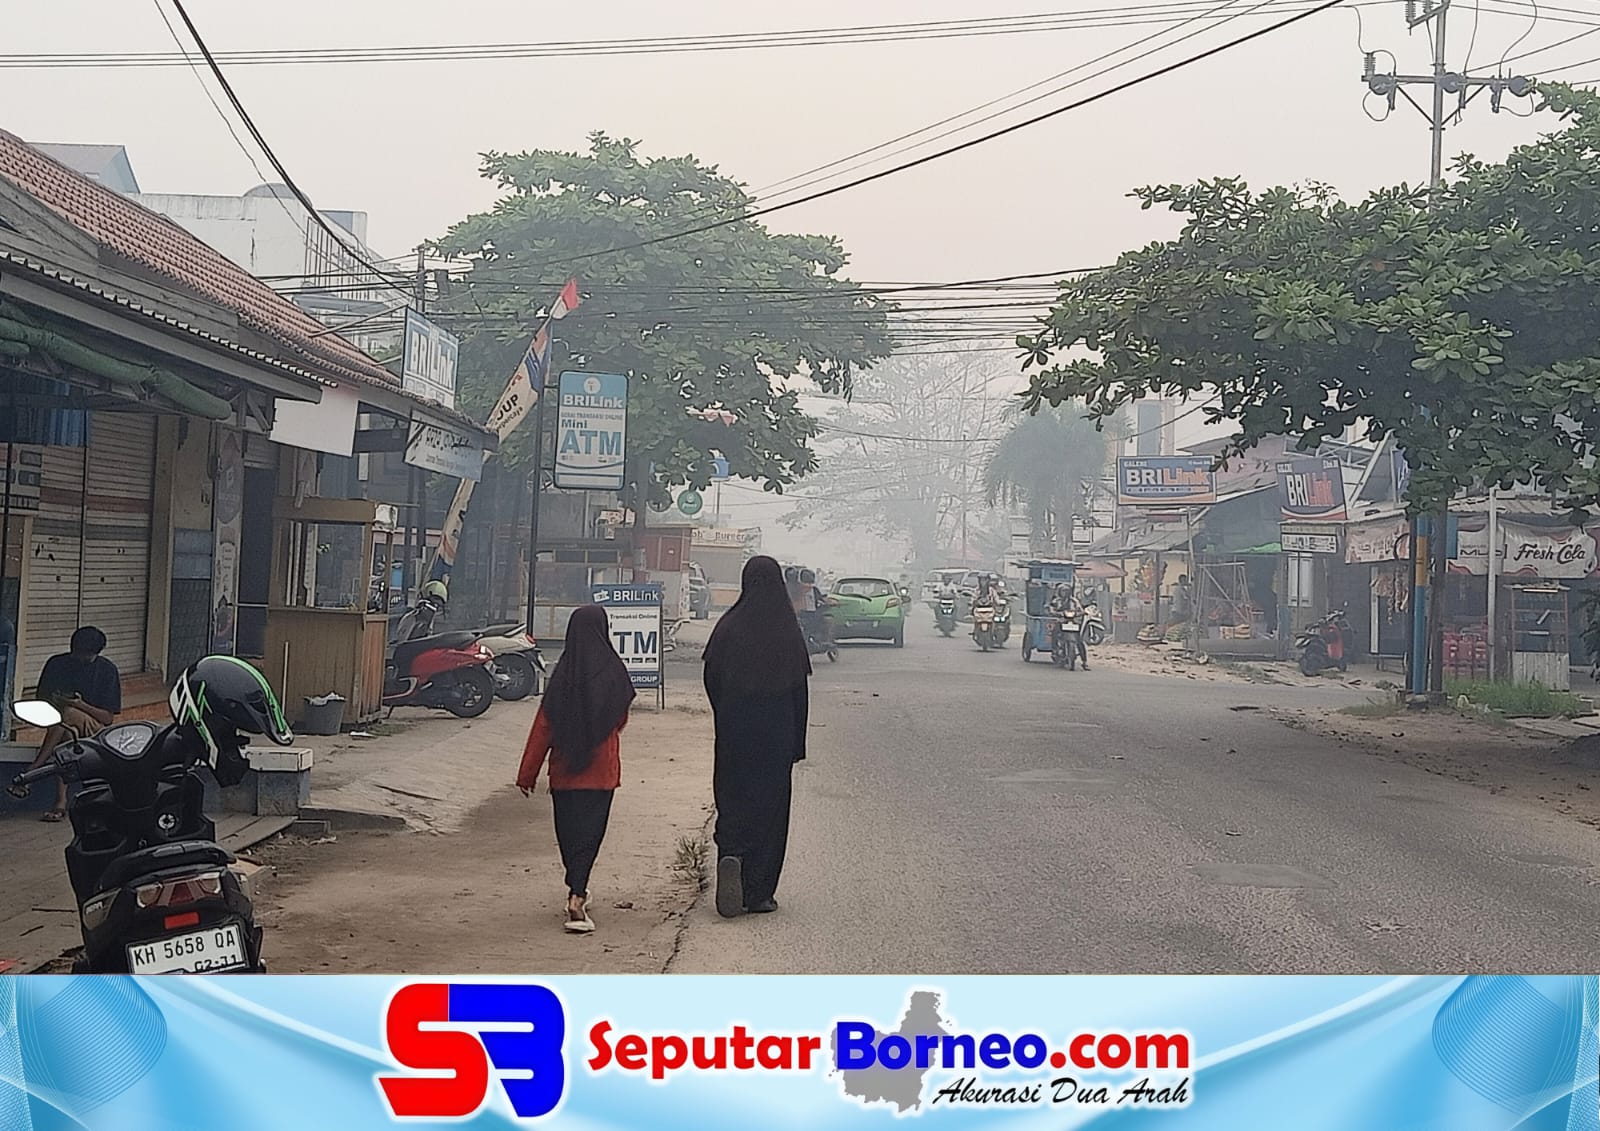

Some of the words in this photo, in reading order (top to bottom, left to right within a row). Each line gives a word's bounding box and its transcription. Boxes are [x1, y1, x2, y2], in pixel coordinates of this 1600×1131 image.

[411, 329, 455, 390] BRILink
[563, 394, 623, 409] BRILink
[561, 419, 587, 429] Mini
[560, 429, 621, 456] ATM
[1126, 467, 1209, 486] BRILink
[1286, 471, 1334, 507] BRILink
[1513, 543, 1554, 561] Fresh
[1557, 543, 1586, 564] Cola
[613, 590, 659, 602] BRILink
[613, 631, 657, 655] TM
[631, 675, 658, 683] GROUP
[133, 946, 156, 966] KH
[164, 937, 205, 959] 5658
[215, 930, 236, 948] QA
